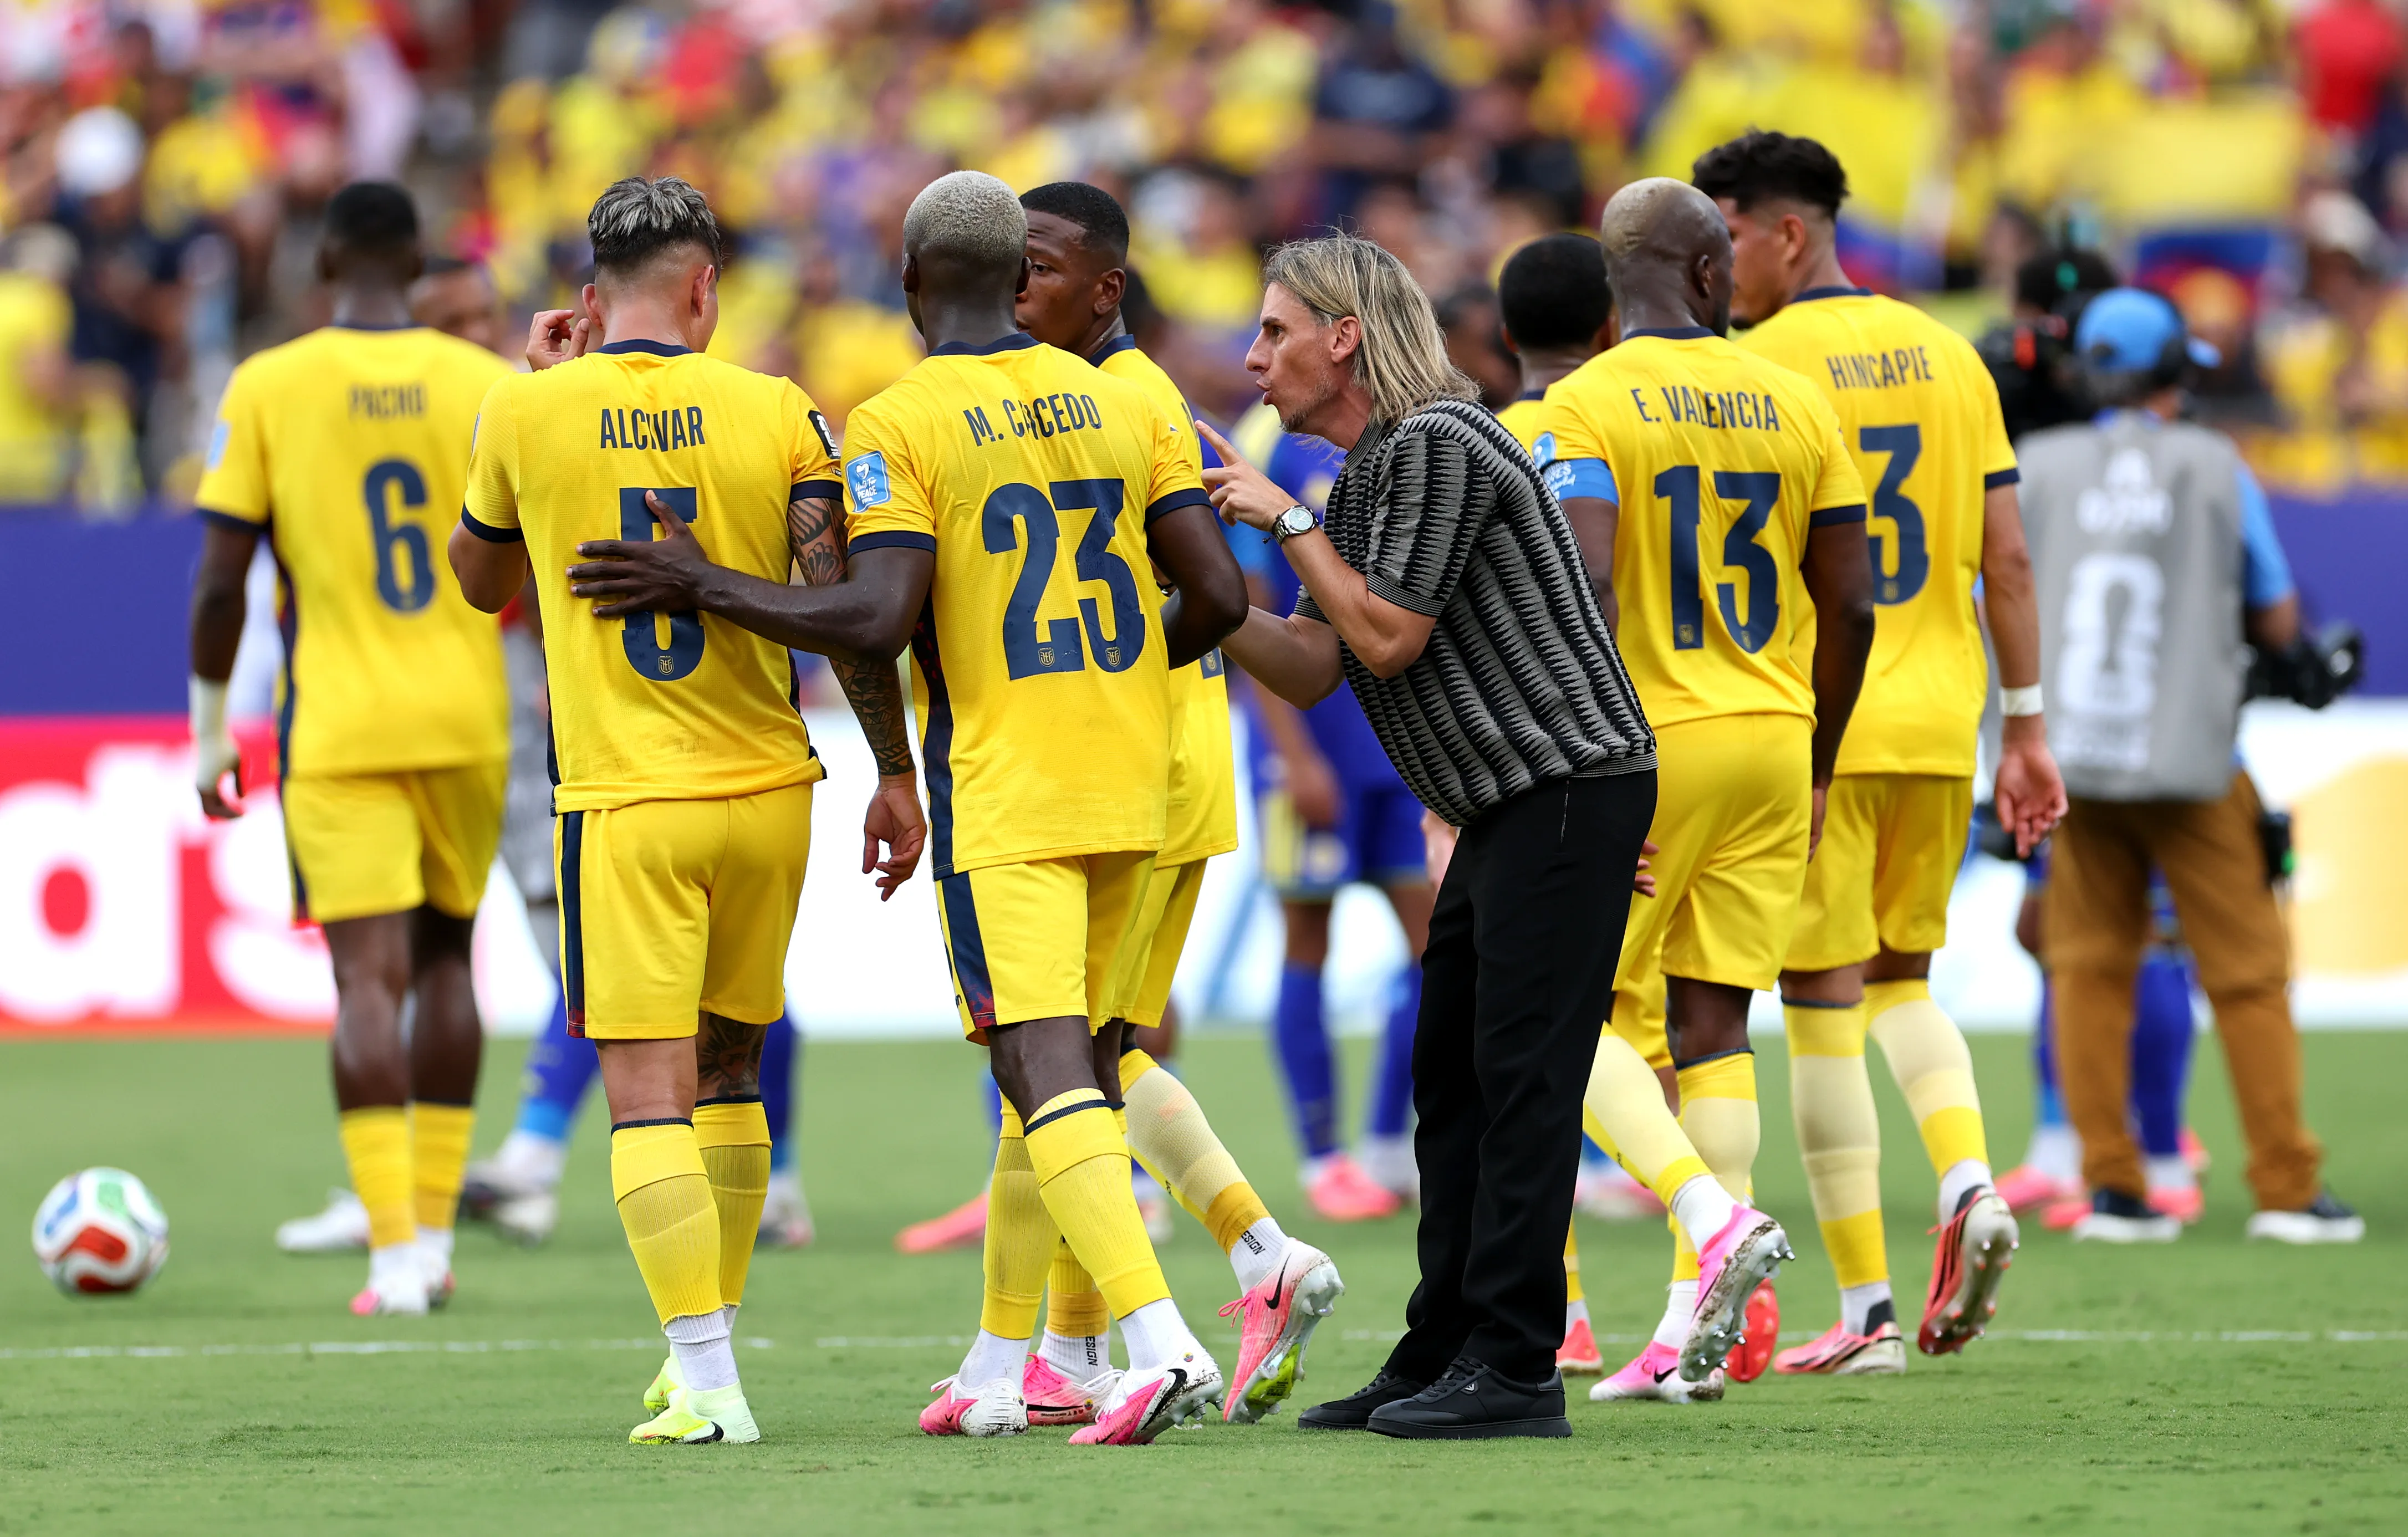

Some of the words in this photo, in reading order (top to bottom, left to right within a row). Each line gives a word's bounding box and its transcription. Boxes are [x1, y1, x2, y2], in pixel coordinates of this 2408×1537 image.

[1826, 346, 1933, 389] HINCAPIE
[963, 406, 1004, 447] M.
[1631, 388, 1661, 422] E.
[1660, 386, 1780, 431] VALENCIA
[857, 485, 878, 501] PEACE
[1860, 424, 1930, 606] 3
[363, 458, 436, 612] 6
[981, 477, 1146, 682] 23
[1654, 464, 1782, 655] 13
[1241, 1230, 1266, 1255] ESIGN
[1085, 1335, 1098, 1366] ESIGN
